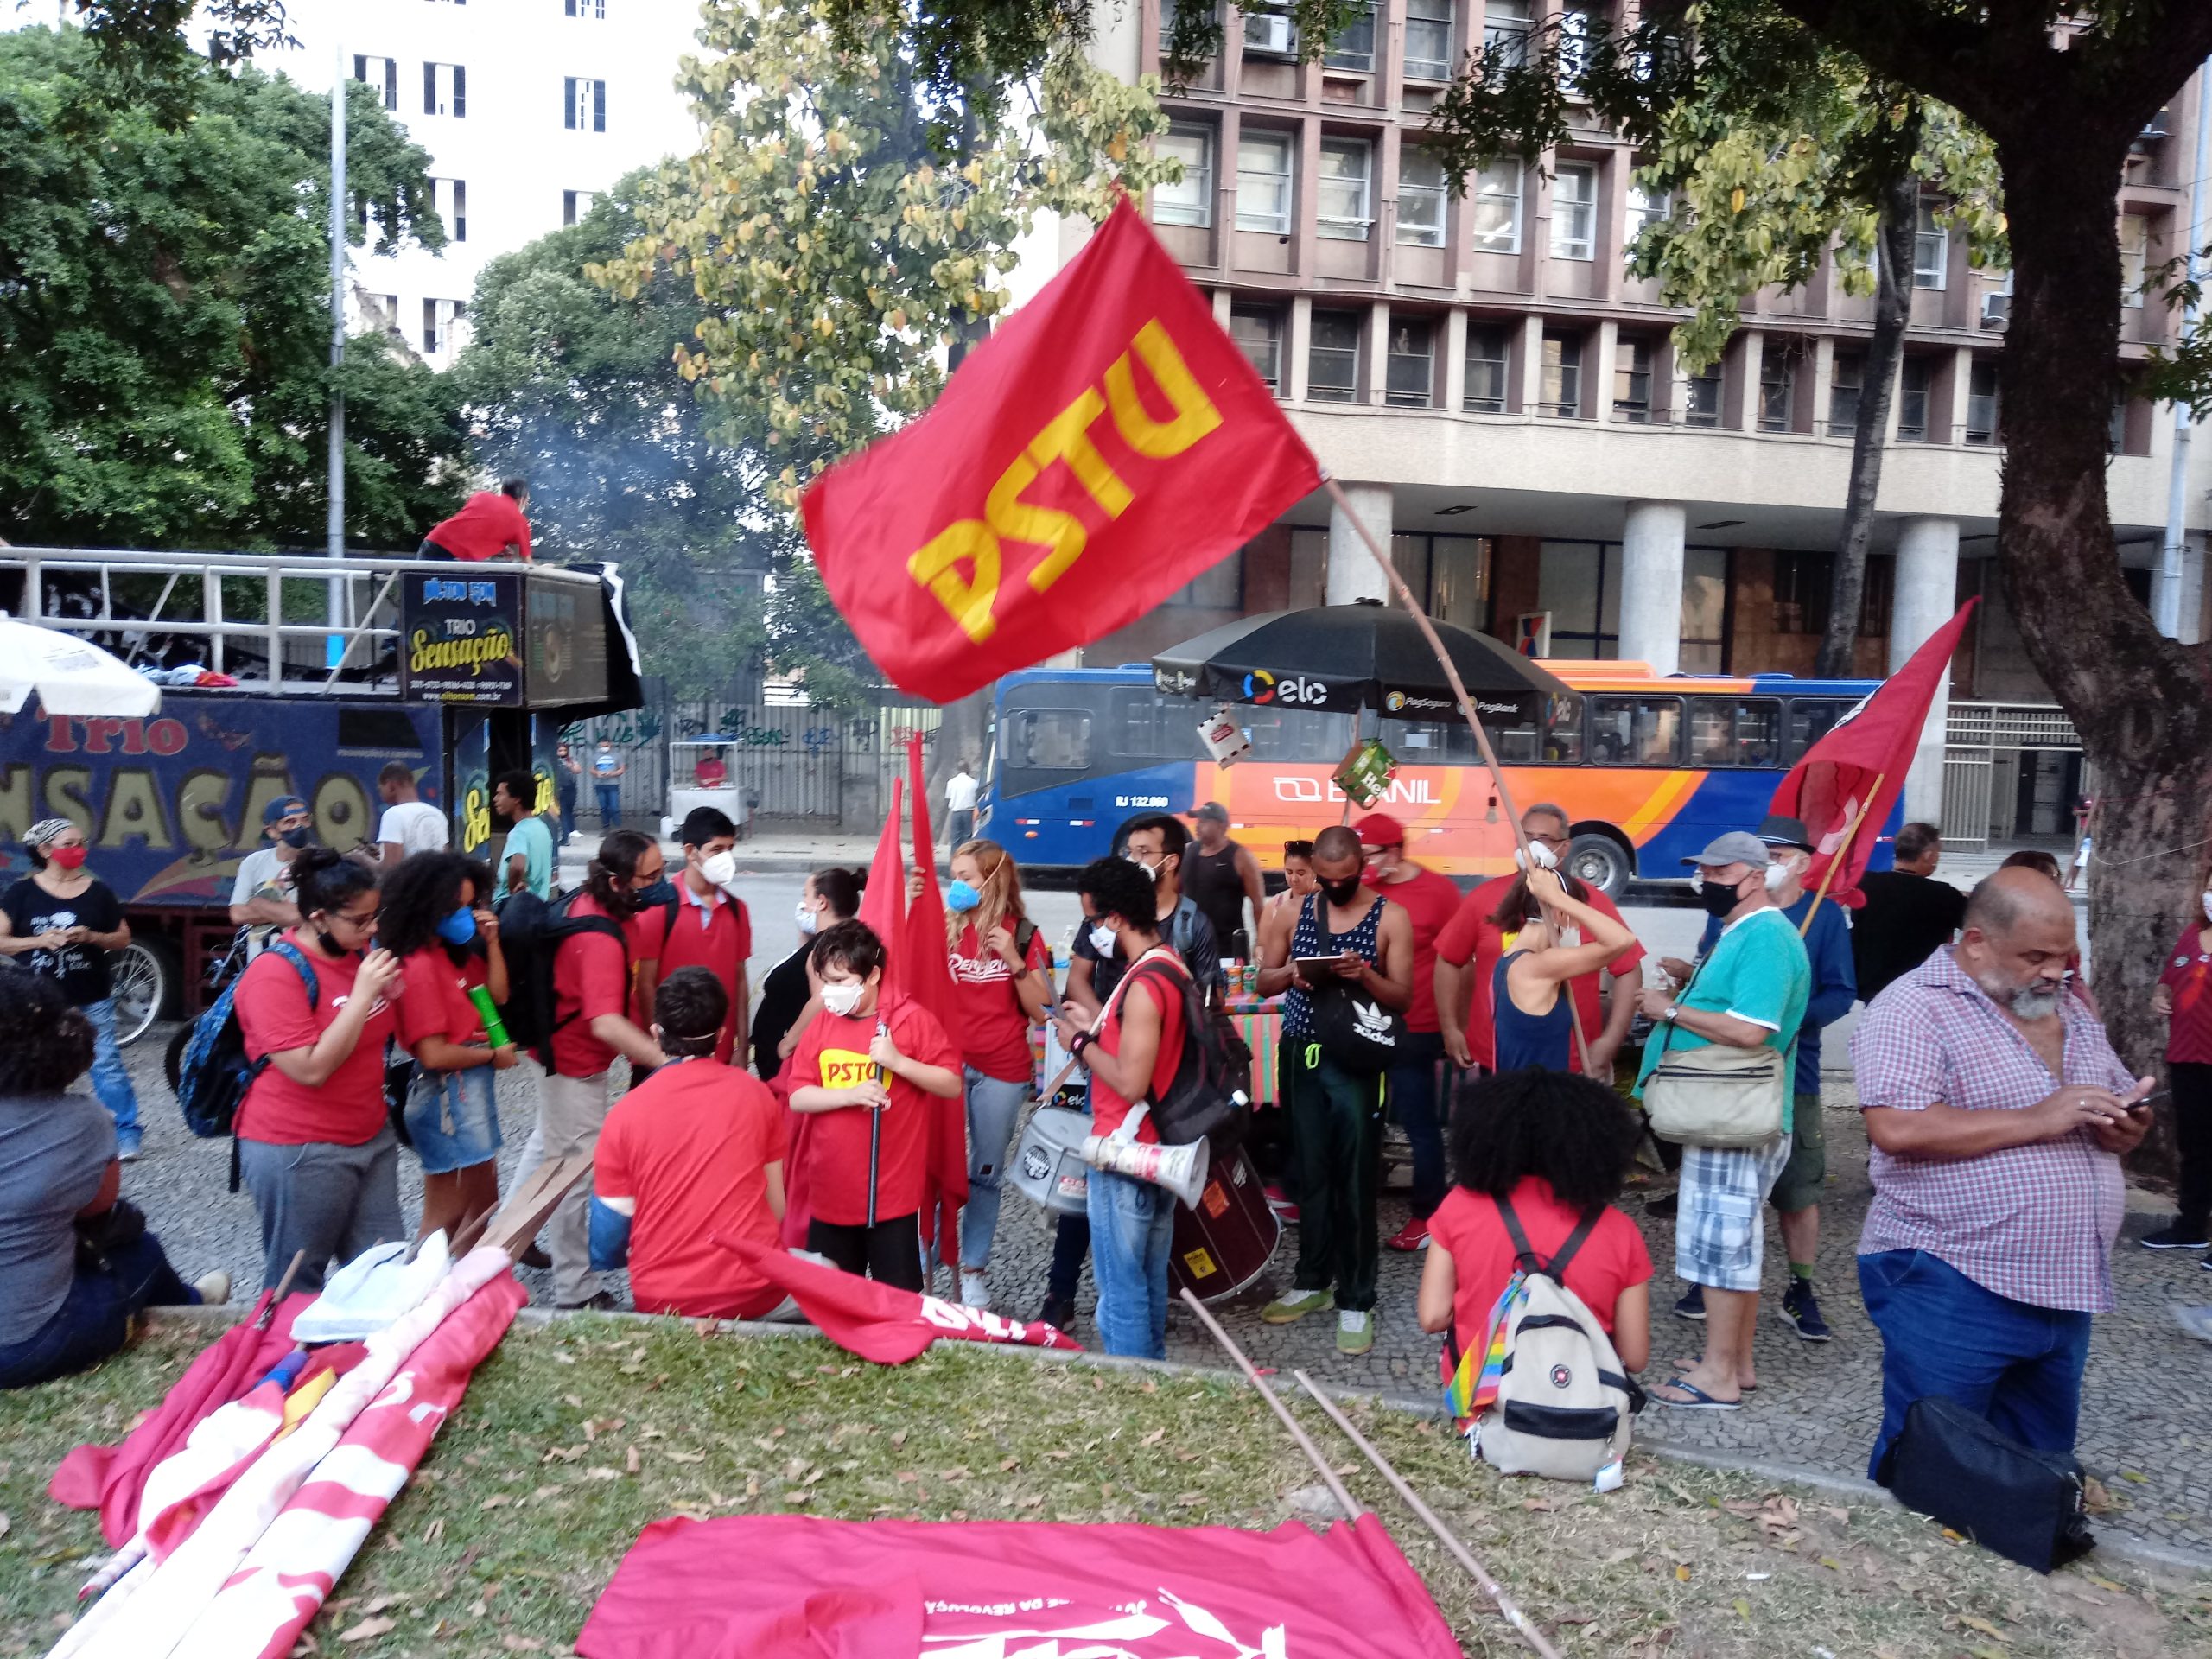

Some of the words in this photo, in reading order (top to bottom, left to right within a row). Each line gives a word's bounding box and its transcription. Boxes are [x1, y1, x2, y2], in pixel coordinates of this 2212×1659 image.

[907, 316, 1224, 645] PSTU
[444, 619, 475, 635] TRIO
[410, 628, 510, 677] Sensação
[1278, 677, 1328, 705] elo
[1405, 696, 1452, 709] PagSeguro
[1477, 702, 1519, 714] PagBank
[1115, 796, 1129, 807] RJ
